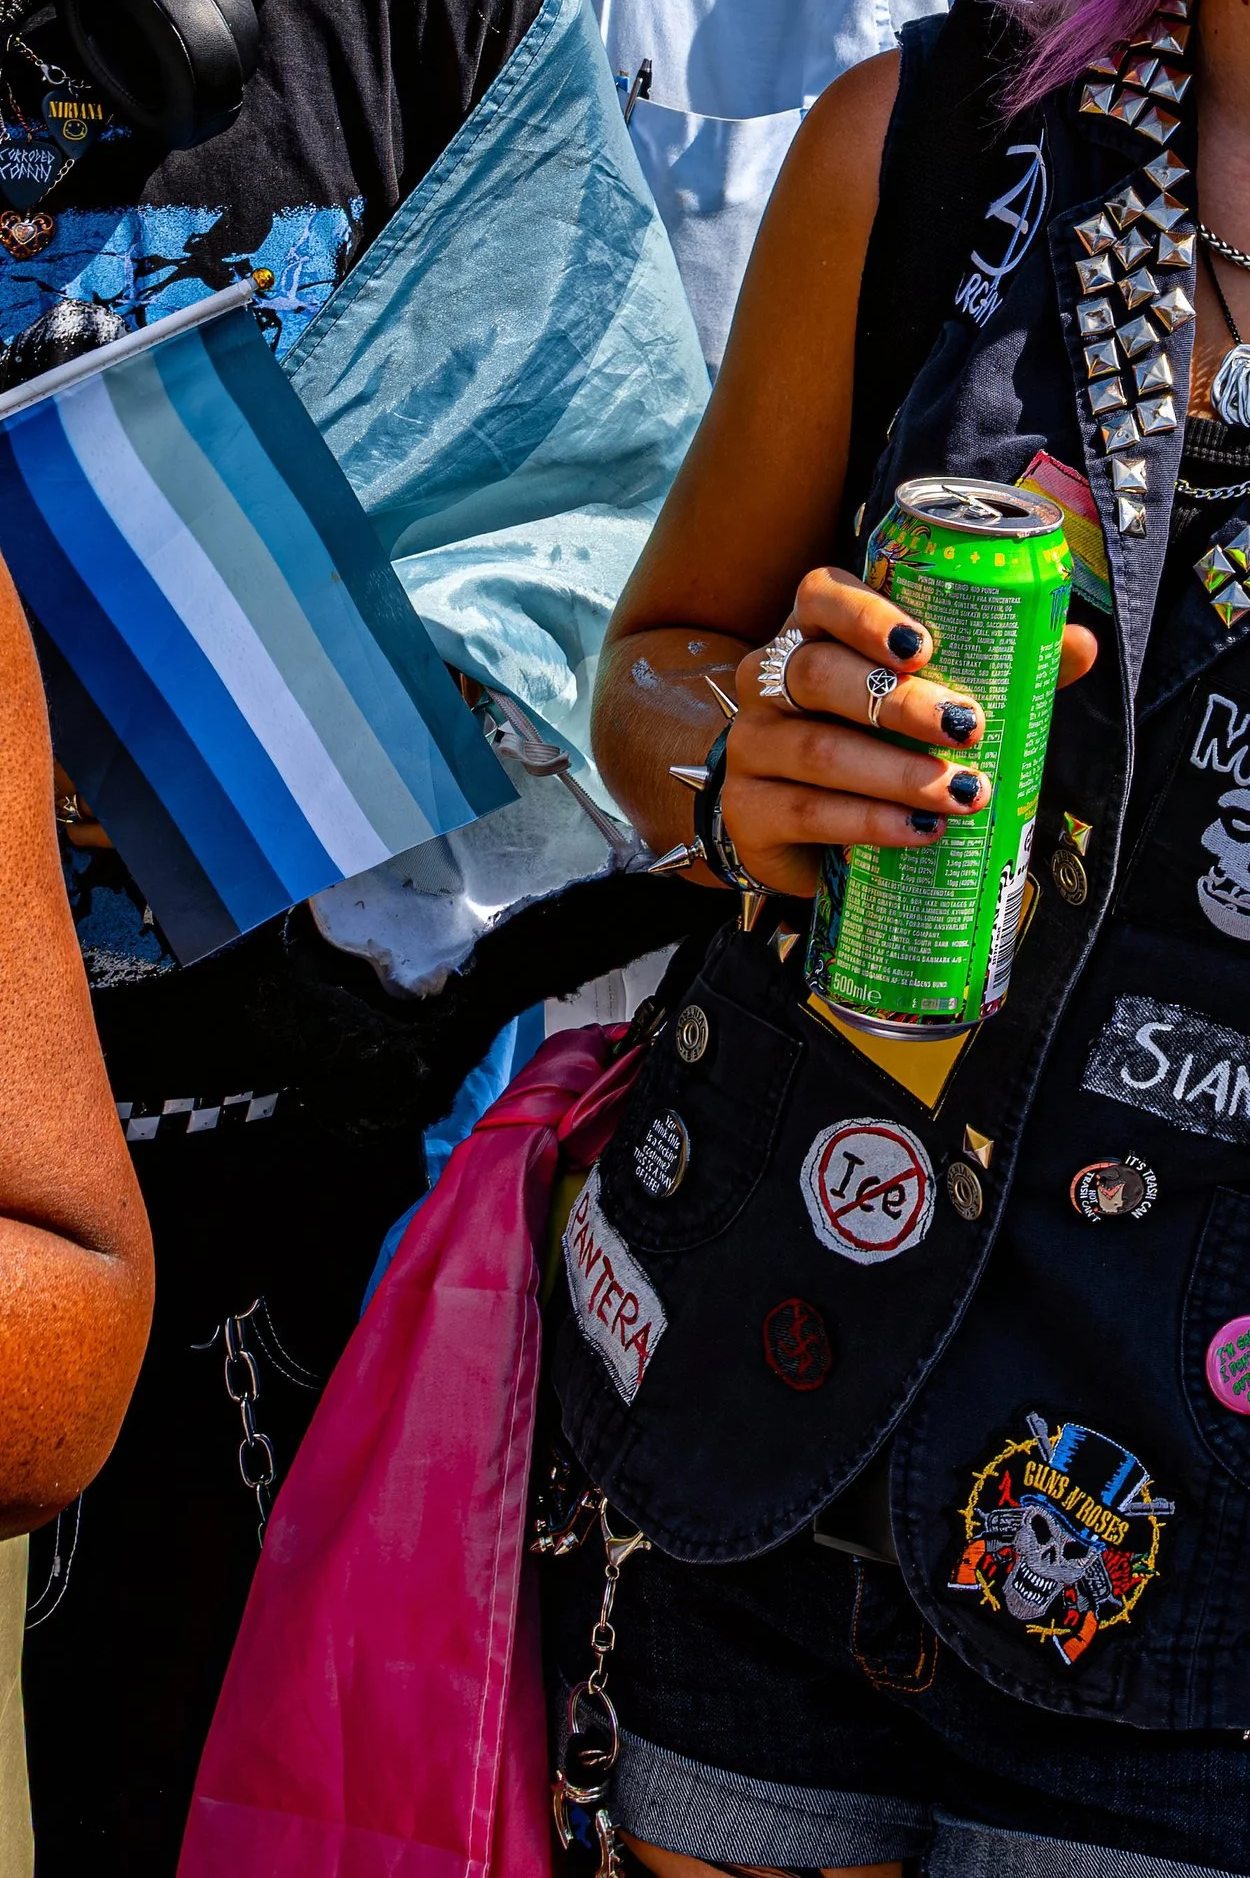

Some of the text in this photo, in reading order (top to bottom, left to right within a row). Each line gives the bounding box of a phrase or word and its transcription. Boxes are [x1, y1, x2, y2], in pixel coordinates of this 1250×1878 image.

[49, 100, 103, 120] NIRVANA
[667, 1132, 681, 1150] this
[635, 1166, 645, 1178] OF
[829, 1150, 907, 1221] Ice
[1080, 1172, 1095, 1199] TRASH
[1124, 1154, 1158, 1220] IT'S TRASH CAN
[569, 1191, 652, 1387] PANTERA
[1023, 1460, 1070, 1500] GUNS
[1075, 1496, 1130, 1546] ROSES
